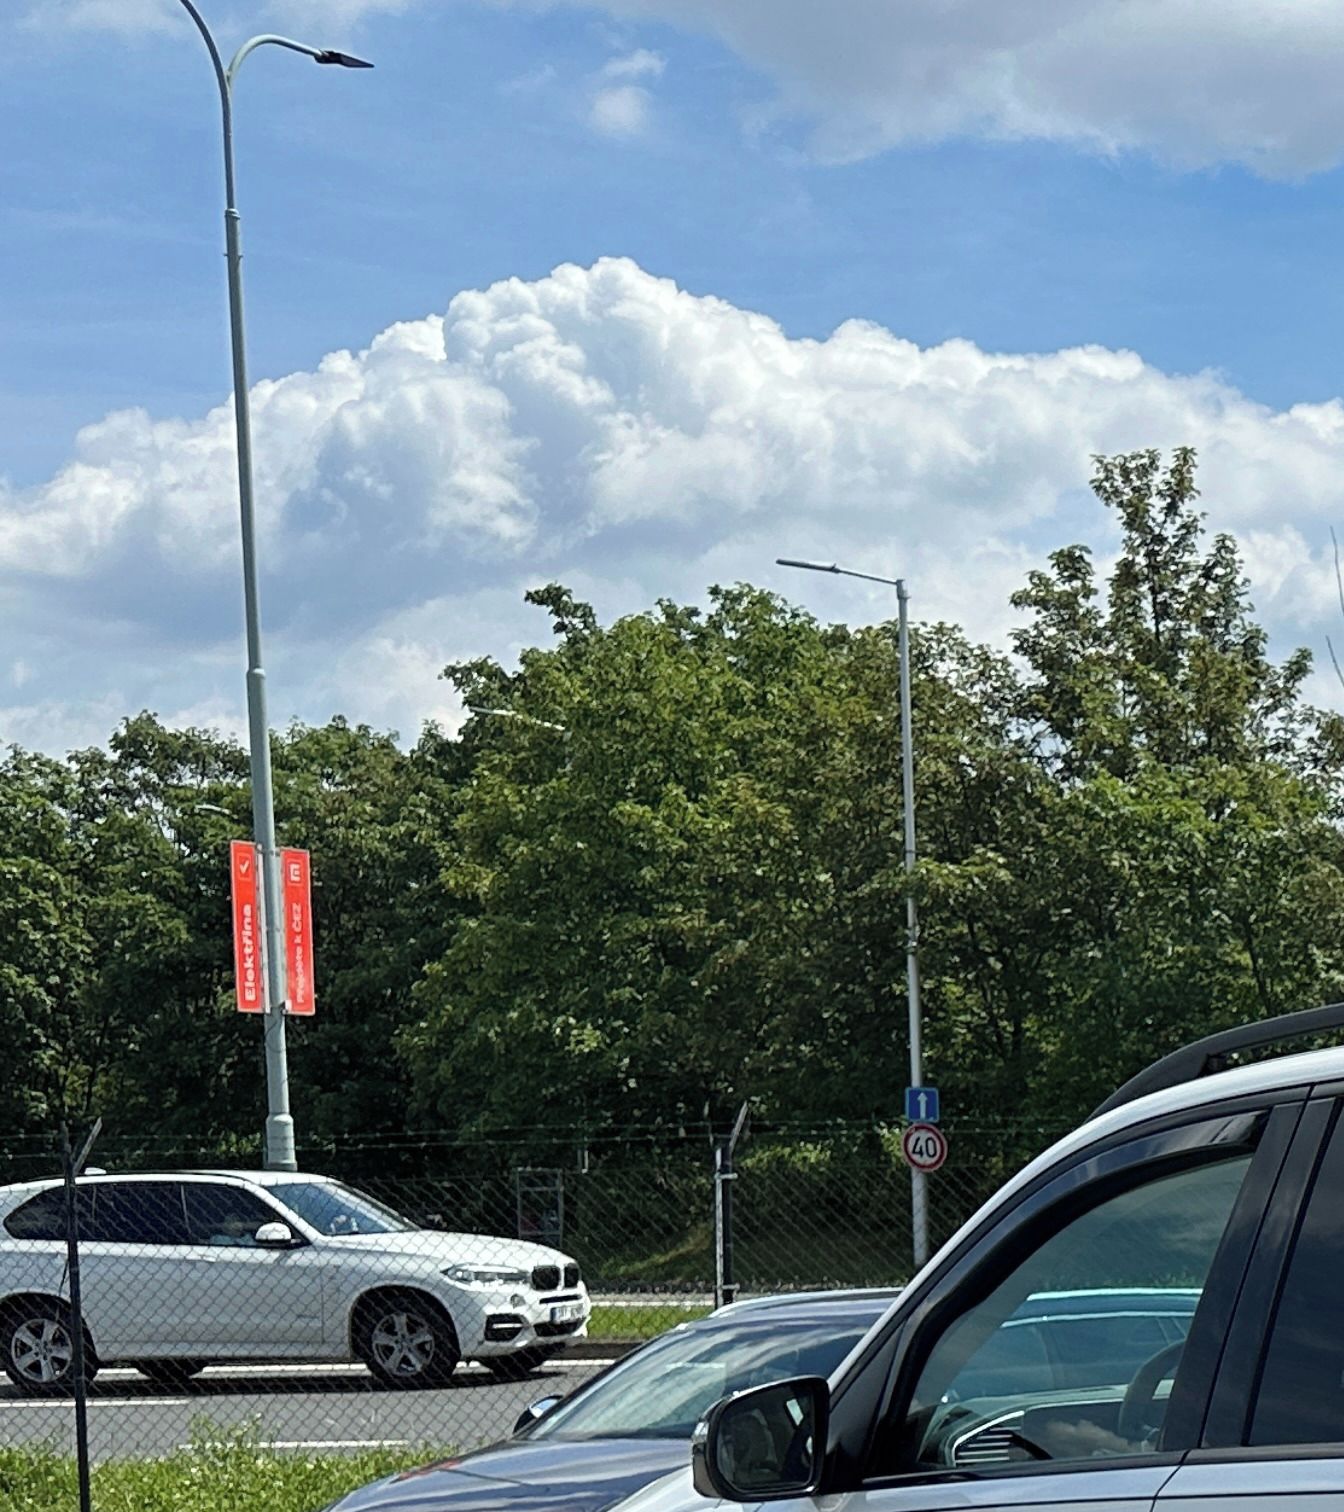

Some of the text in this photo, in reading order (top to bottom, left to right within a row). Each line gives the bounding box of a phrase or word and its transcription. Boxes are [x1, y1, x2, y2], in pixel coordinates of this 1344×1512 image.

[291, 902, 302, 933] ČEZ
[242, 904, 256, 1001] Elektřina
[912, 1136, 937, 1158] 40
